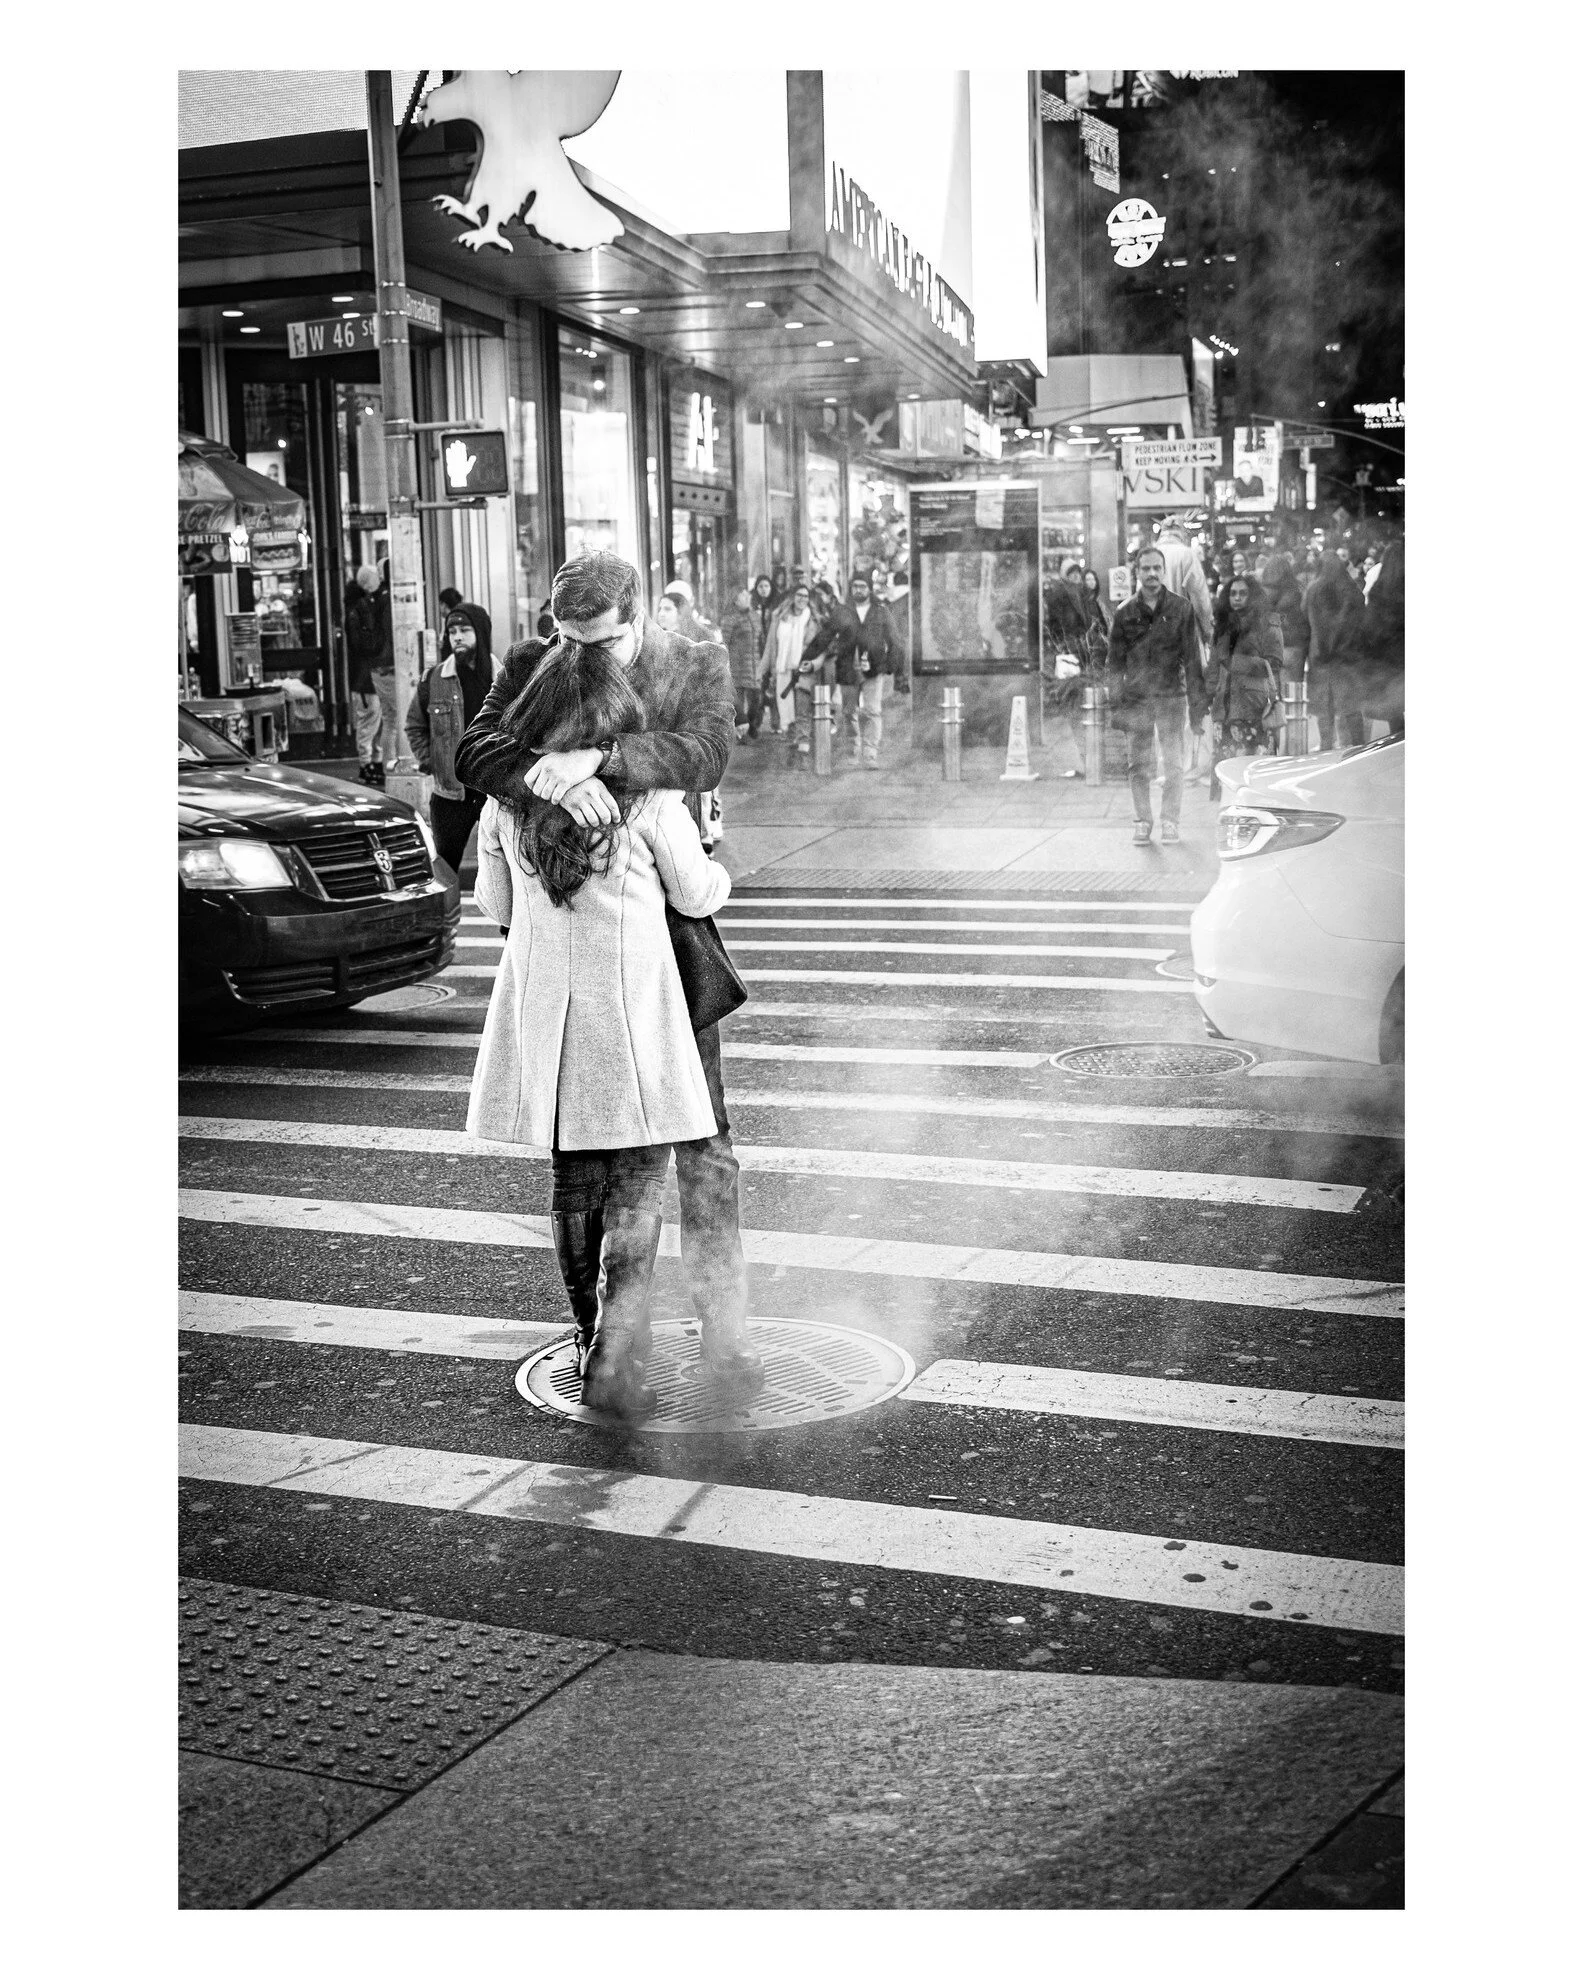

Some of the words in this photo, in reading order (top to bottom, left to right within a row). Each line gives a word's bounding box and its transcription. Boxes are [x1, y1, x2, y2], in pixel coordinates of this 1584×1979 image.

[308, 325, 324, 351] W
[333, 322, 355, 348] 46
[362, 319, 374, 337] St
[1134, 443, 1177, 455] PEDESTRIAN
[1179, 442, 1197, 452] FLOW
[1199, 441, 1216, 452] ZONE
[1135, 456, 1152, 466] KEEP
[1154, 454, 1180, 465] MOVING
[188, 534, 224, 546] PRETZEL
